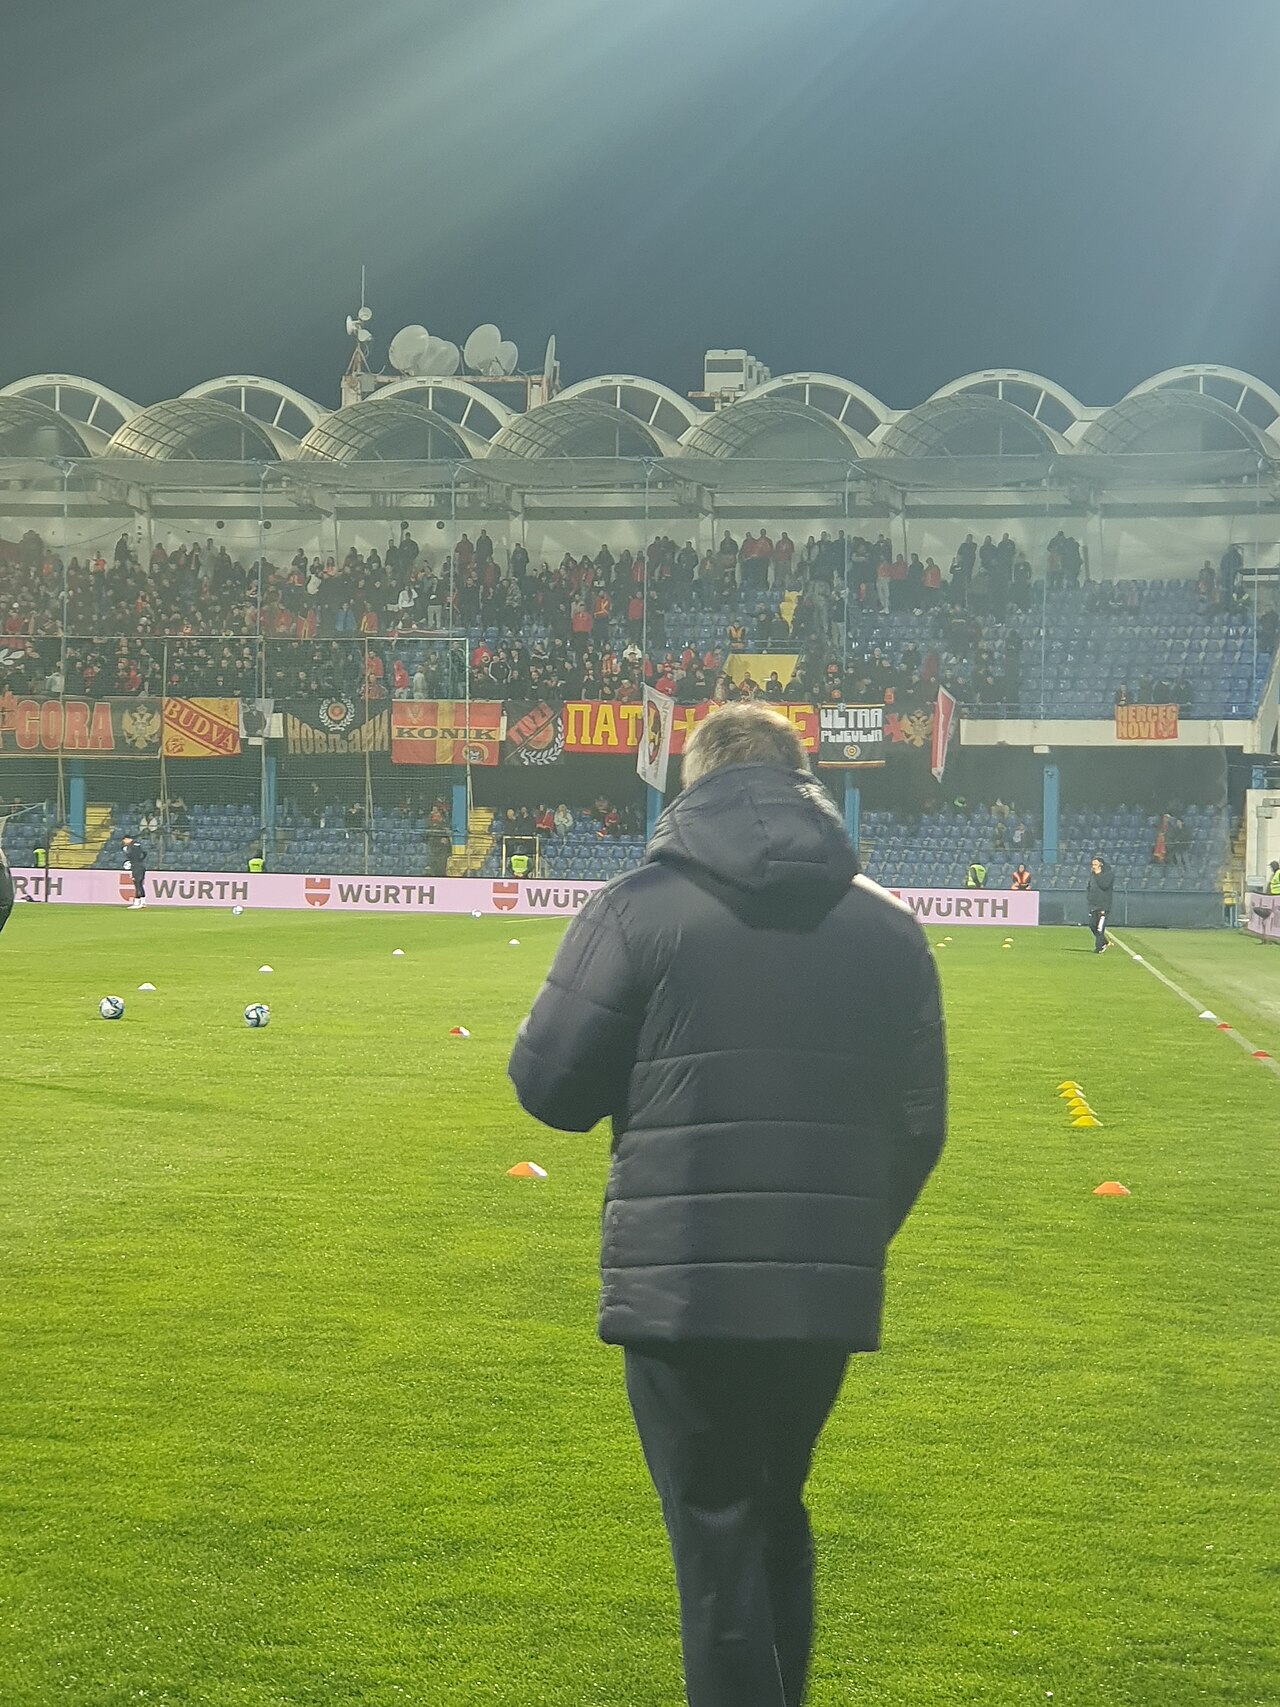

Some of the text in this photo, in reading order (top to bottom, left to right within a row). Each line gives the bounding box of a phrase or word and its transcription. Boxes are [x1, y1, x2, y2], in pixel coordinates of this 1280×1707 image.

[16, 700, 115, 750] GORA
[164, 699, 234, 752] BUDVA
[395, 726, 496, 740] KONIK
[566, 703, 645, 746] ПАТ
[1117, 721, 1155, 738] NOVI
[13, 876, 63, 896] RTH
[152, 879, 248, 900] WÜRTH
[338, 883, 435, 905] WÜRTH
[526, 887, 597, 908] WÜR
[908, 896, 1008, 918] WÜRTH
